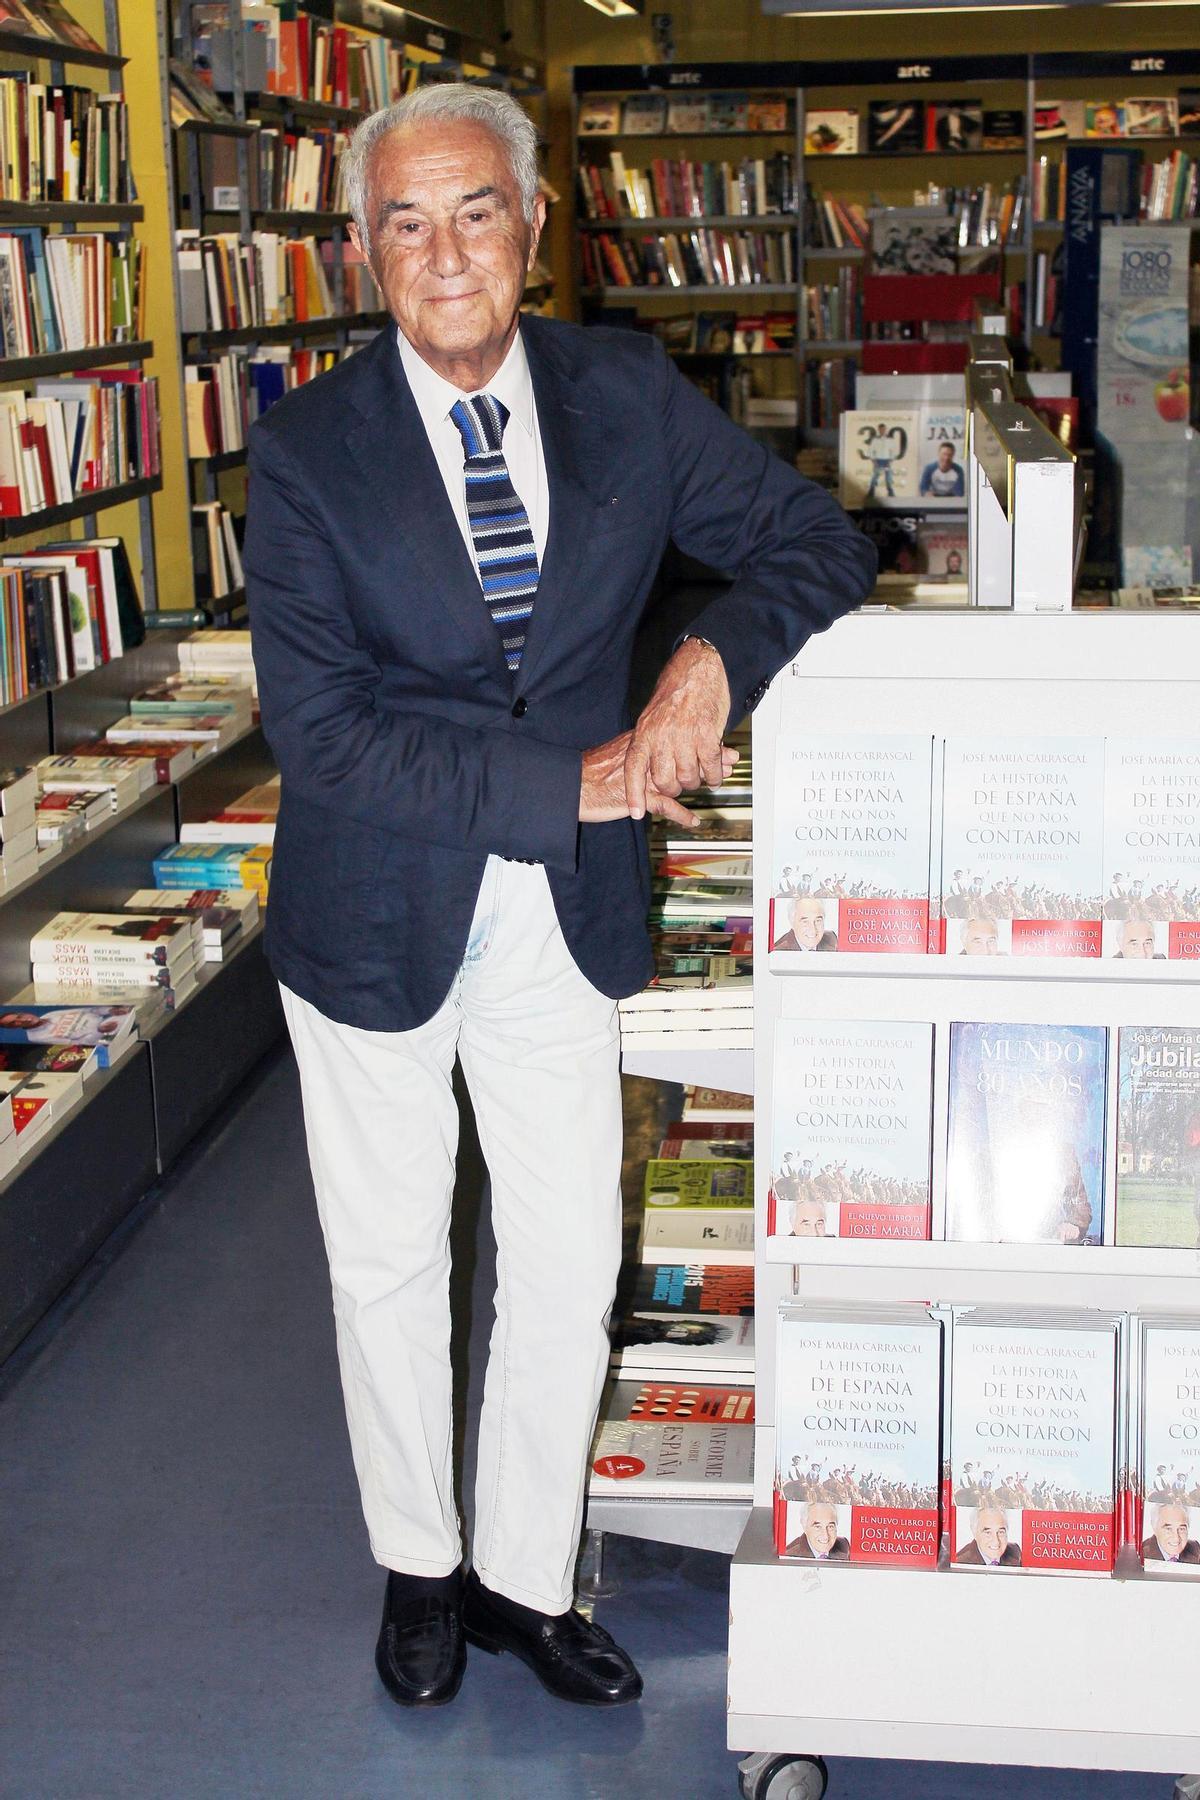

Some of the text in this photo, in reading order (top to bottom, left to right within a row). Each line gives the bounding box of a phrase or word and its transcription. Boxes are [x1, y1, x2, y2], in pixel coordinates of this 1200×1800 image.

[1071, 165, 1090, 244] ANAYA
[854, 752, 915, 761] CARRASCAL
[1024, 754, 1088, 764] CARRASCAL
[811, 770, 896, 782] LA HISTORIA
[982, 773, 1068, 785] LA HISTORIA
[1142, 775, 1157, 786] LA
[802, 786, 904, 804] DE ESPAÑA
[973, 789, 1076, 807] DE ESPAÑA
[1133, 792, 1157, 808] DE
[808, 809, 896, 823] QUE NO NOS
[979, 812, 1069, 825] QUE NO NOS
[1138, 814, 1196, 827] QUE NO
[794, 826, 908, 842] CONTARON
[965, 829, 1081, 846] CONTARON
[858, 908, 885, 917] NUEVO
[886, 909, 909, 917] LIBRO
[911, 909, 924, 917] DE
[848, 919, 923, 933] JOSÉ MARÍA
[848, 933, 922, 946] CARRASCAL
[55, 943, 87, 953] MASS
[52, 954, 89, 965] BLACK
[58, 967, 90, 976] MASS
[855, 1037, 914, 1049] CARRASCAL
[980, 1039, 1083, 1064] MUNDO
[812, 1057, 896, 1070] LA HISTORIA
[1146, 1068, 1172, 1078] edad
[804, 1073, 904, 1091] DE ESPAÑA
[976, 1071, 1004, 1093] 80
[809, 1095, 896, 1108] QUE NO NOS
[796, 1112, 908, 1130] CONTARON
[859, 1213, 886, 1221] NUEVO
[888, 1214, 910, 1222] LIBRO
[849, 1223, 877, 1236] JOSÉ
[685, 1265, 704, 1287] 2015
[862, 1343, 923, 1354] CARRASCAL
[1035, 1347, 1098, 1359] CARRASCAL
[820, 1360, 904, 1374] LA HISTORIA
[992, 1365, 1078, 1380] LA HISTORIA
[812, 1377, 912, 1396] DE ESPAÑA
[984, 1382, 1086, 1402] DE ESPAÑA
[816, 1399, 905, 1413] QUE NO NOS
[989, 1405, 1079, 1419] QUE NO NOS
[803, 1415, 918, 1436] CONTARON
[976, 1421, 1091, 1442] CONTARON
[656, 1426, 684, 1478] ESPAÑA
[687, 1440, 702, 1463] SOBRE
[704, 1427, 728, 1478] INFORME
[815, 1440, 905, 1451] MITOS Y REALIDADES
[988, 1445, 1079, 1458] MITOS Y REALIDADES
[860, 1516, 869, 1524] EL
[872, 1516, 897, 1526] NUEVO
[900, 1518, 923, 1526] LIBRO
[1031, 1520, 1109, 1532] EL NUEVO LIBRO DE
[861, 1526, 935, 1542] JOSÉ MARÍA
[1032, 1531, 1108, 1547] JOSÉ MARÍA
[861, 1540, 934, 1556] CARRASCAL
[1032, 1546, 1107, 1561] CARRASCAL
